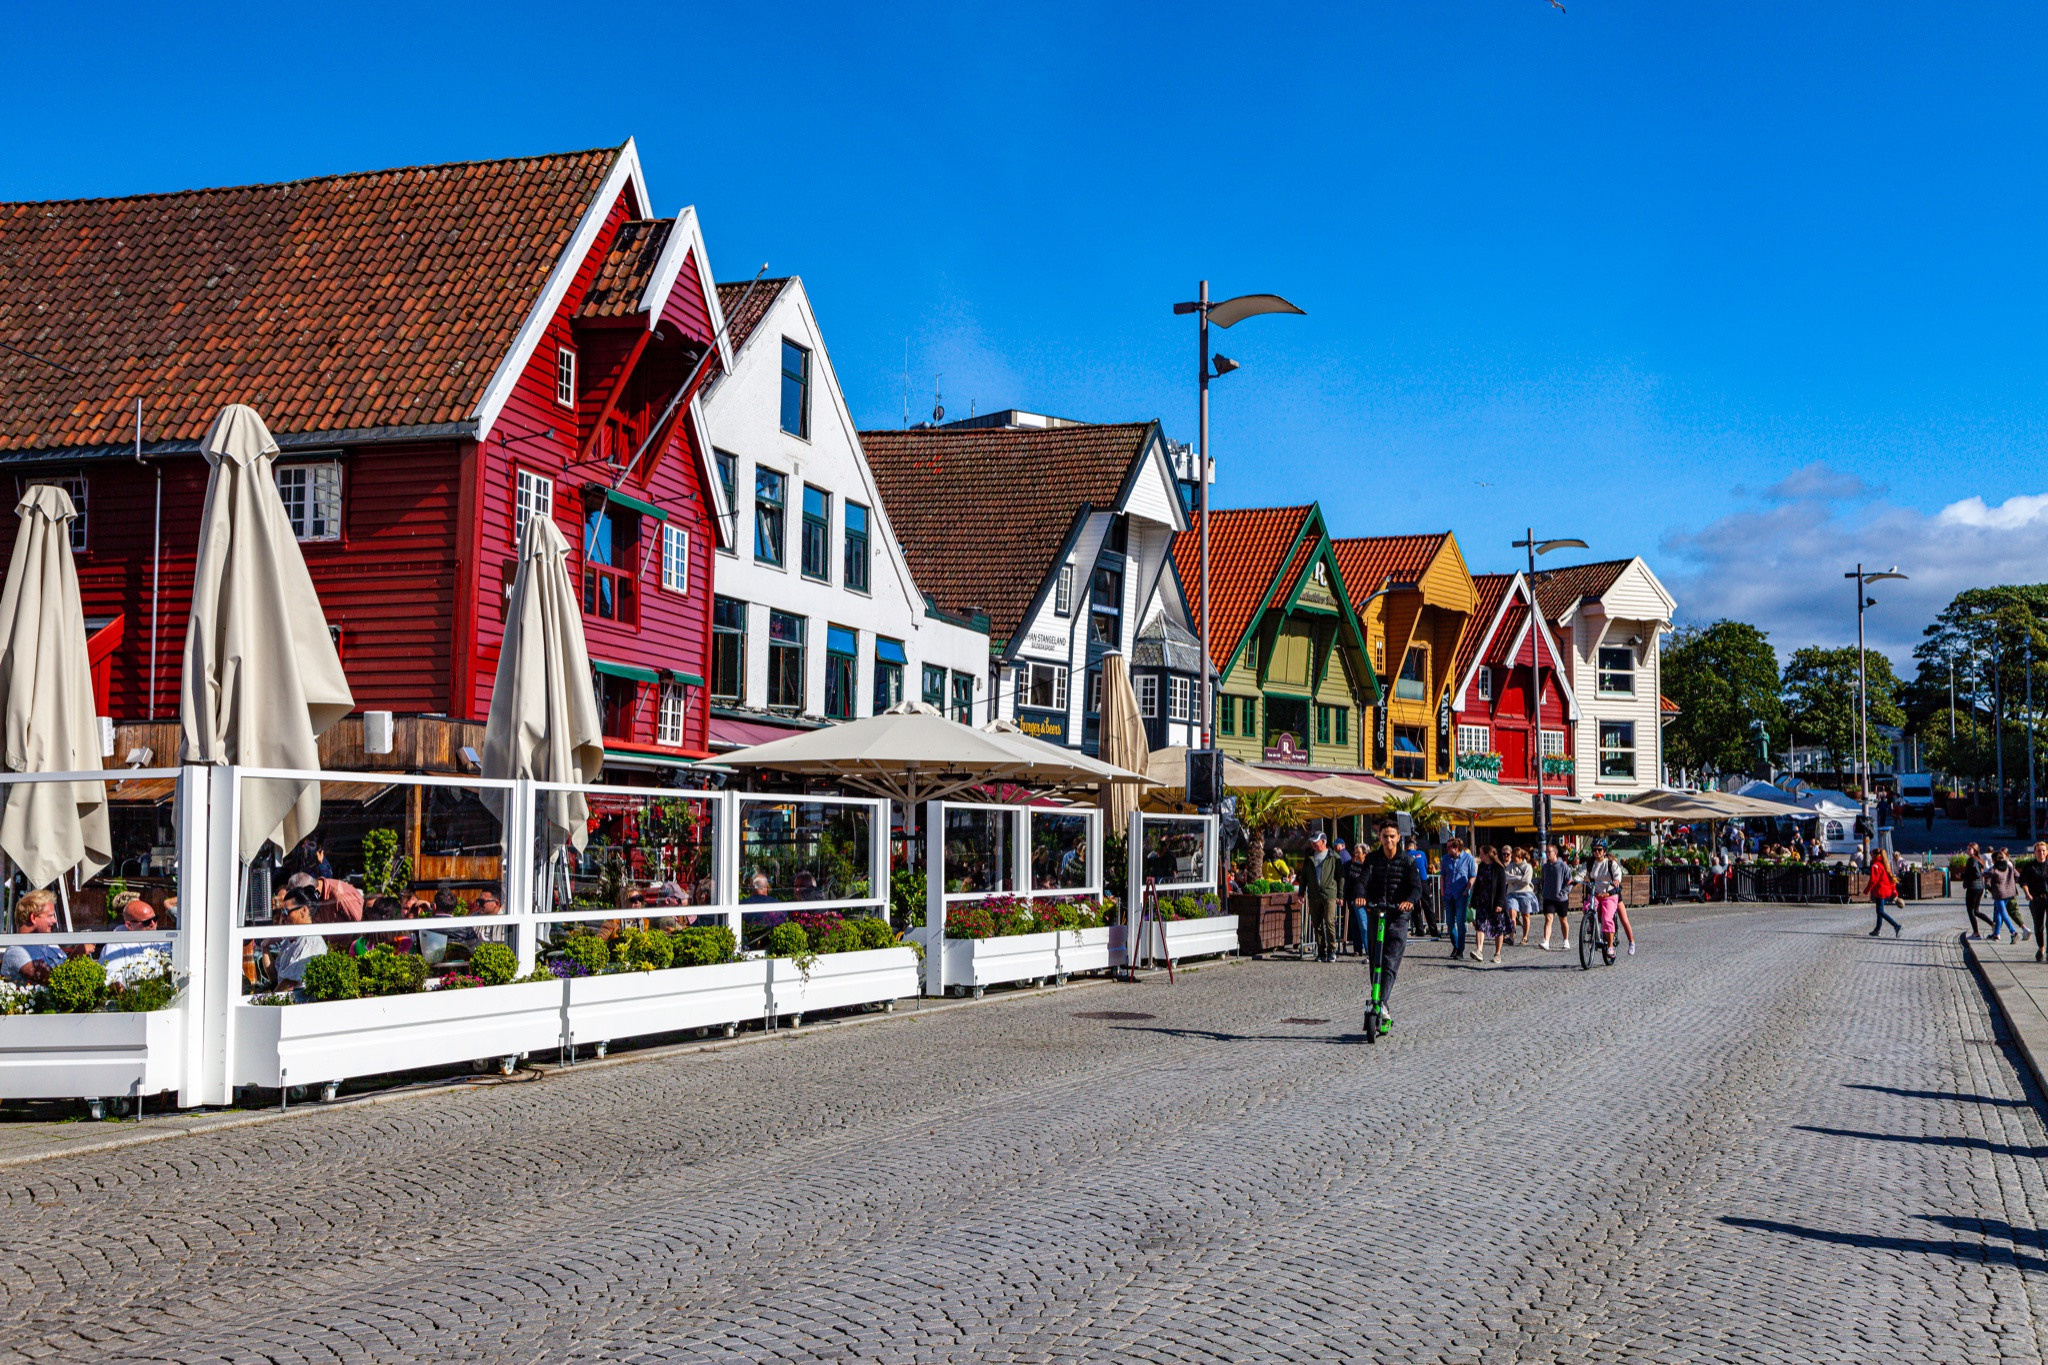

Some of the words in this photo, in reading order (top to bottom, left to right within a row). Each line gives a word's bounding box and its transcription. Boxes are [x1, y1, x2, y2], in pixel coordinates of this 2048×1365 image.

[1314, 561, 1328, 587] R
[505, 583, 514, 599] M
[1037, 634, 1067, 646] STANGELAND
